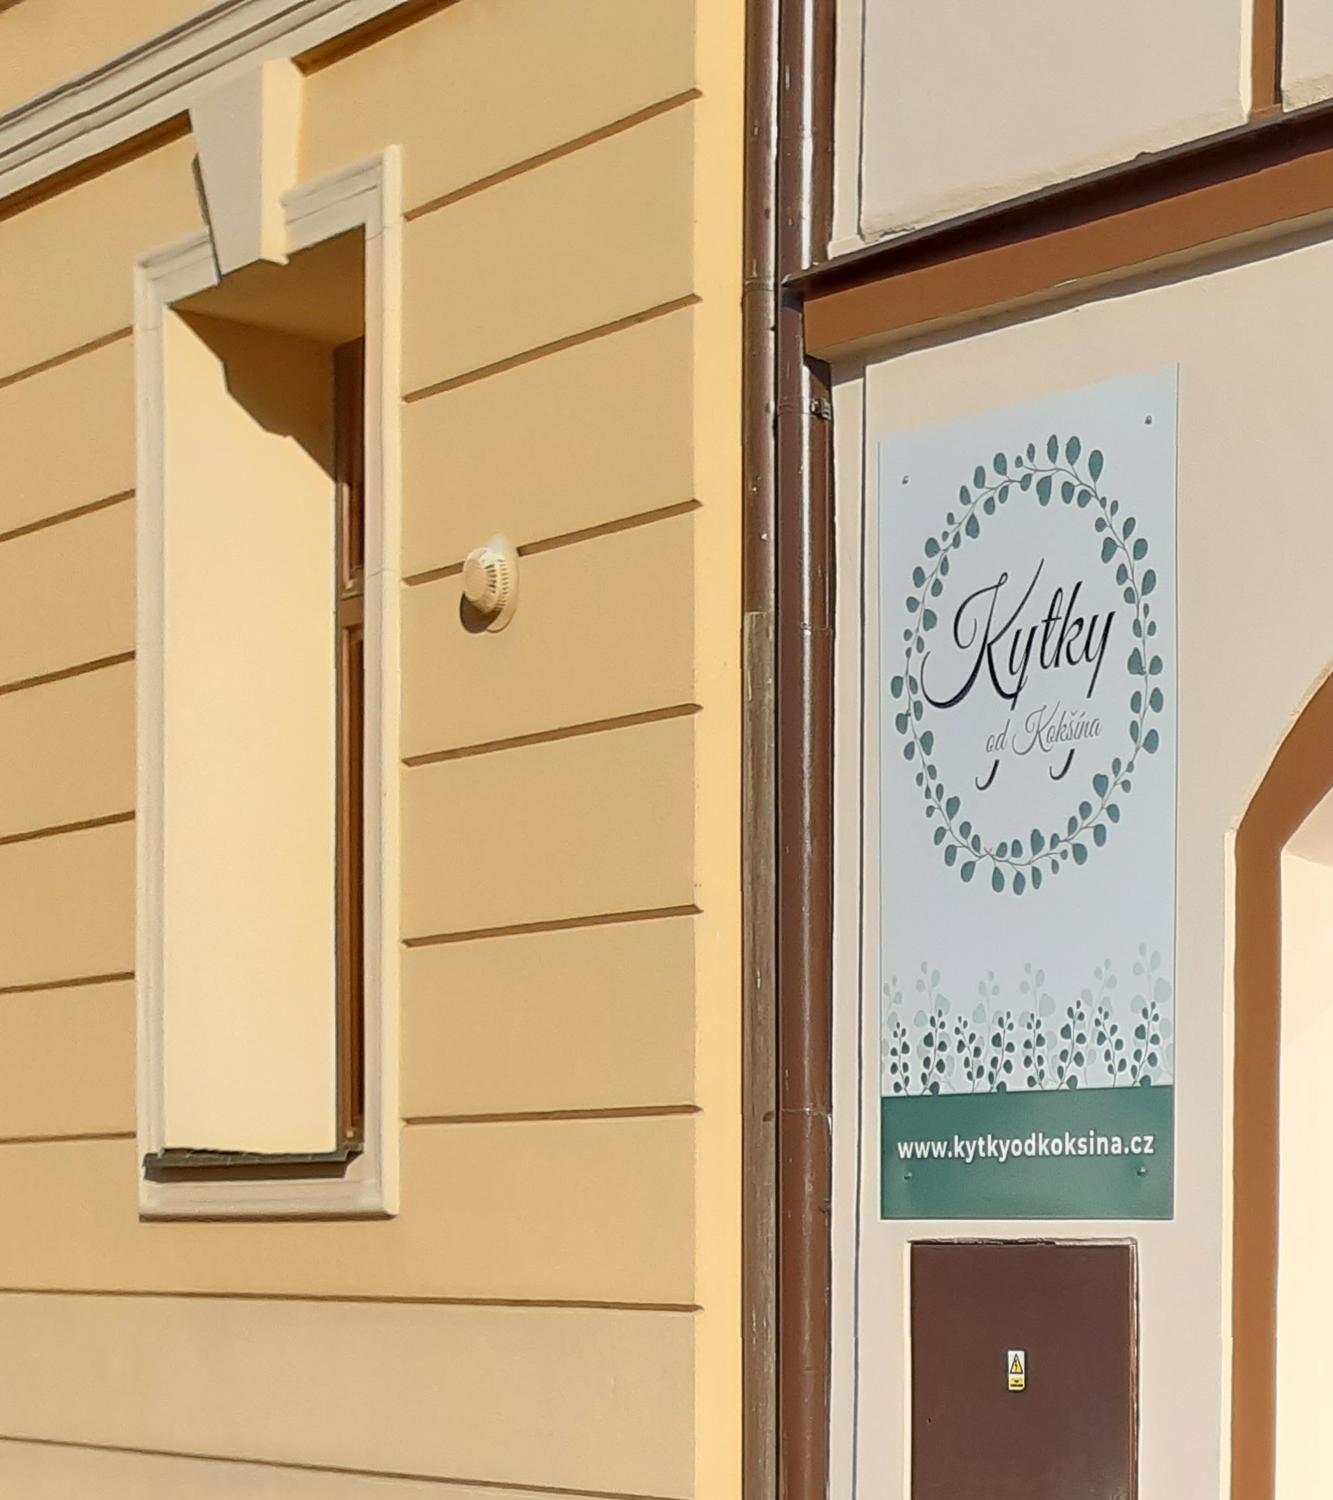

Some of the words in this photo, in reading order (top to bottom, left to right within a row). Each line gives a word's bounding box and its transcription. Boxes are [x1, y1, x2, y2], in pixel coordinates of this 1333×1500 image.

[986, 719, 1010, 753] od
[1012, 700, 1102, 755] Kokšína
[897, 1130, 1155, 1163] www.kytkyodkoksina.cz
